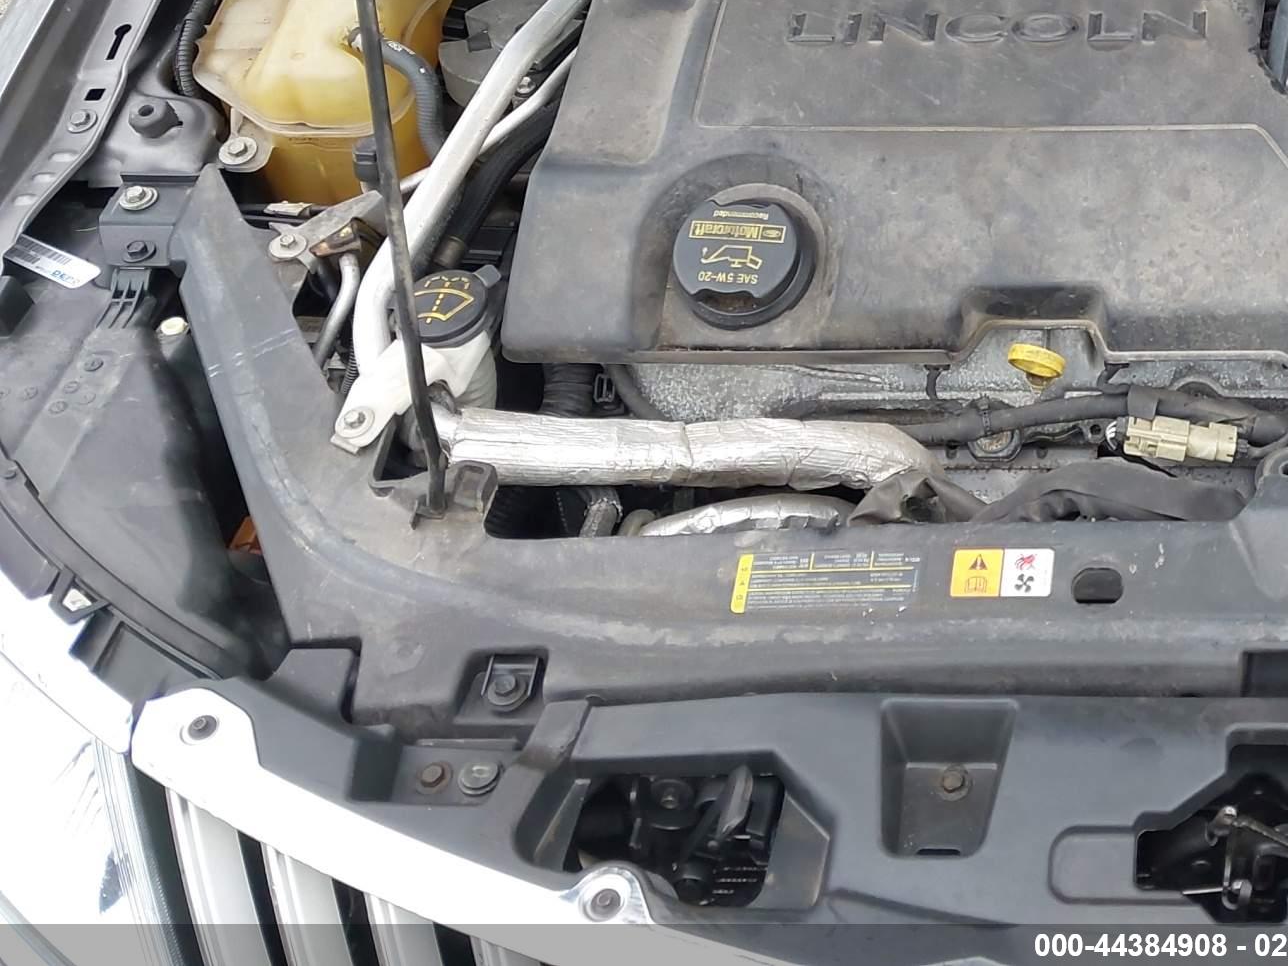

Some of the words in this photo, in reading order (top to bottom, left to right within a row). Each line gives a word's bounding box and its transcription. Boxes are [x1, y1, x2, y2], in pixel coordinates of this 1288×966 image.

[786, 11, 1208, 44] LINCOLN
[694, 223, 759, 239] Motorcraft
[697, 270, 734, 283] 5W-20
[736, 273, 759, 285] SAE
